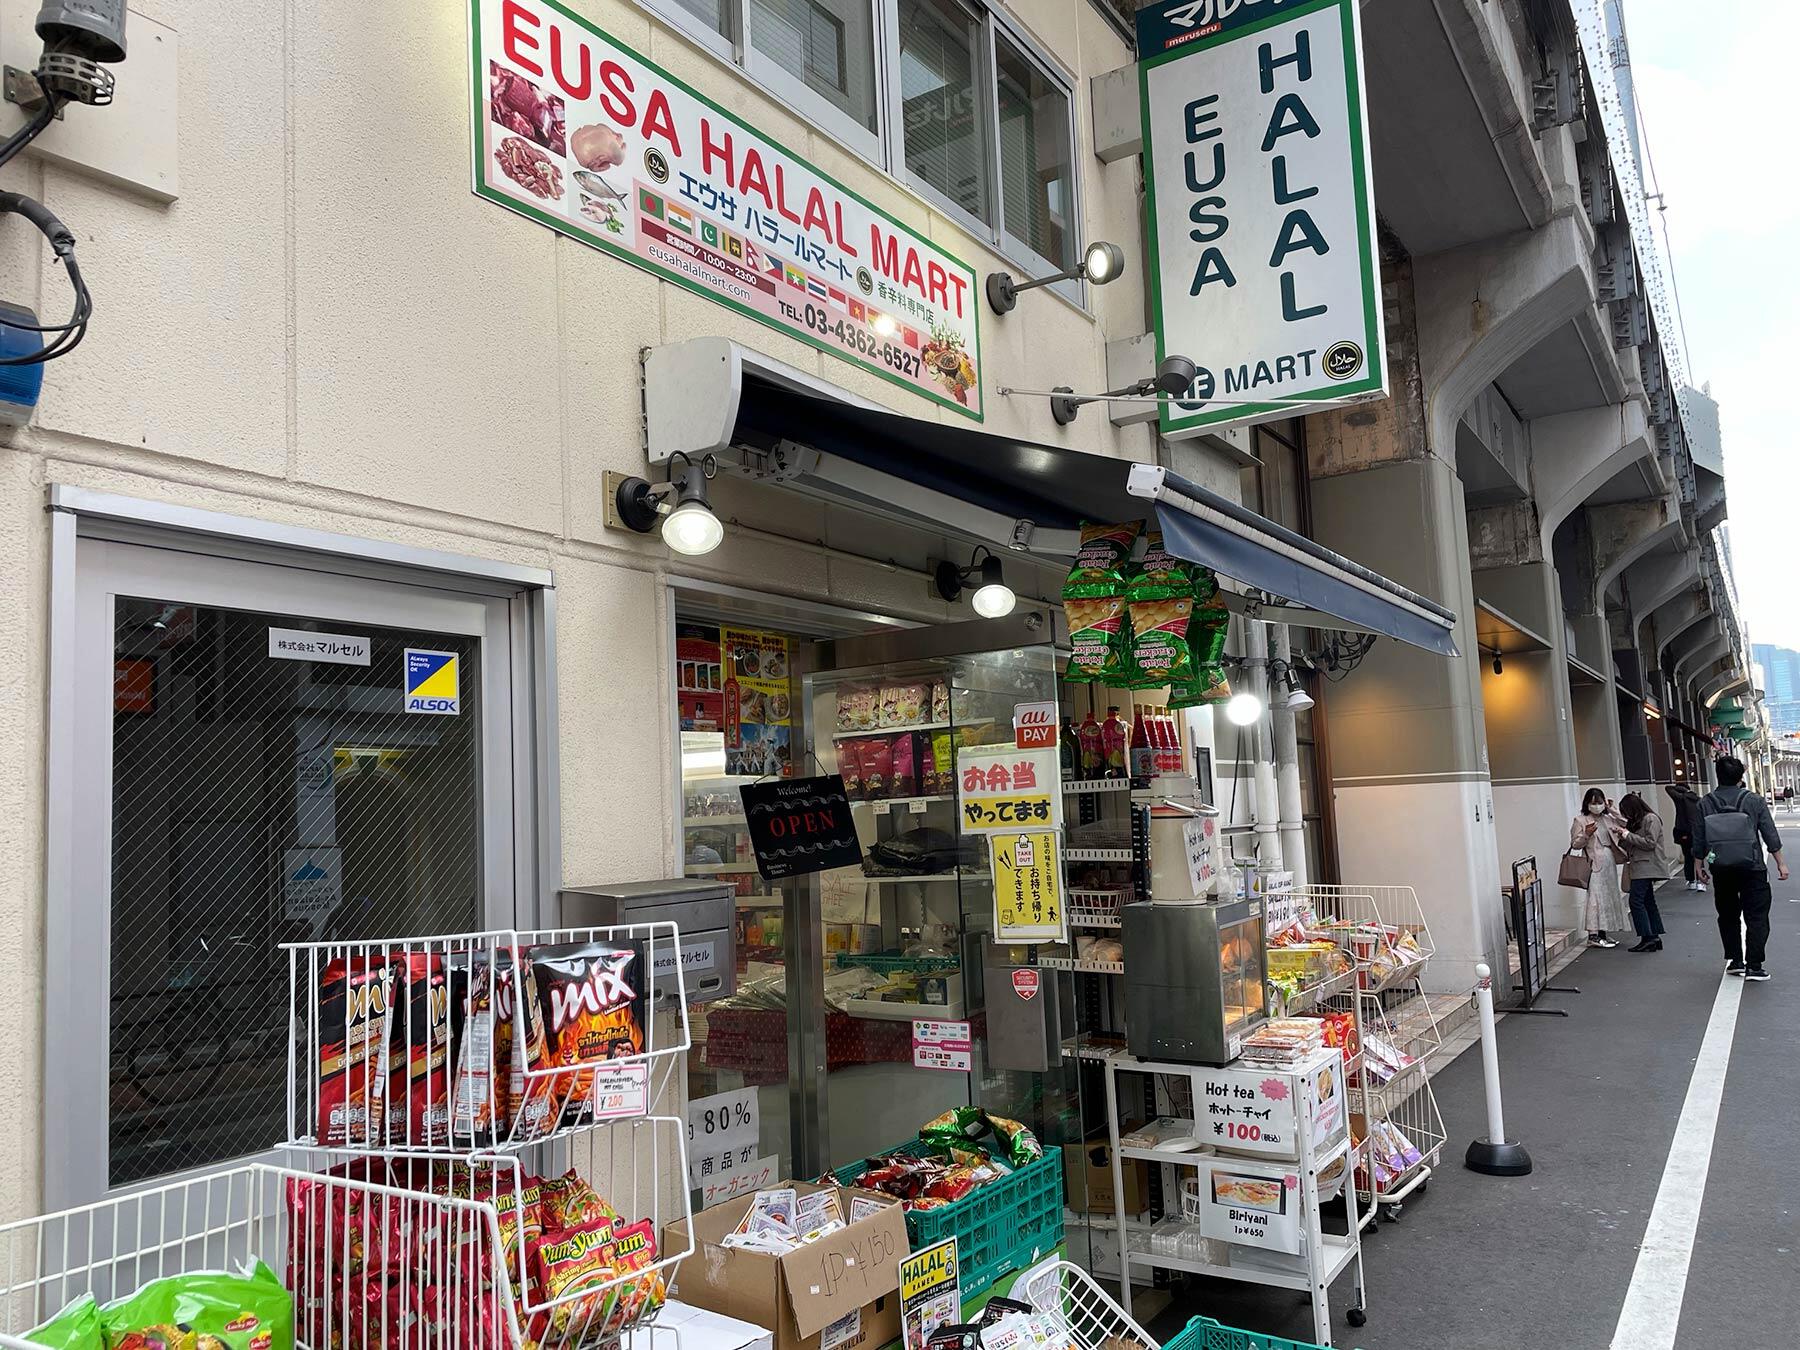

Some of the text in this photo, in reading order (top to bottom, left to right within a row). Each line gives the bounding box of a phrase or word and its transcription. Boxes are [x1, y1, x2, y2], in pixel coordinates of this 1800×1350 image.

[1168, 24, 1218, 47] maruseru
[501, 2, 968, 320] EUSA HALAL MART
[1257, 29, 1330, 322] HALAL
[1183, 94, 1237, 297] EUSA
[679, 171, 853, 281] エウサ ハラールマート
[648, 244, 751, 301] eusahalalmart.com
[877, 281, 935, 326] 香辛料専門店
[778, 299, 921, 379] TEL: 03-4362-6527
[1224, 349, 1317, 393] MART
[278, 640, 364, 657] 株式会社マルセル
[409, 700, 457, 712] ALSOK
[1022, 709, 1051, 725] au
[1023, 728, 1050, 742] PAY
[777, 784, 812, 796] Welcome!
[963, 761, 1037, 793] お弁当
[769, 809, 835, 837] OPEN
[965, 799, 1051, 824] やってます
[1030, 867, 1042, 923] お持ち帰り
[1205, 1082, 1255, 1099] Hot tea
[706, 1167, 772, 1201] オーガニック
[1229, 1209, 1268, 1226] Biriyani
[557, 1265, 582, 1283] Shrimp
[903, 1251, 945, 1286] HALAL
[912, 1275, 935, 1291] RAMEN
